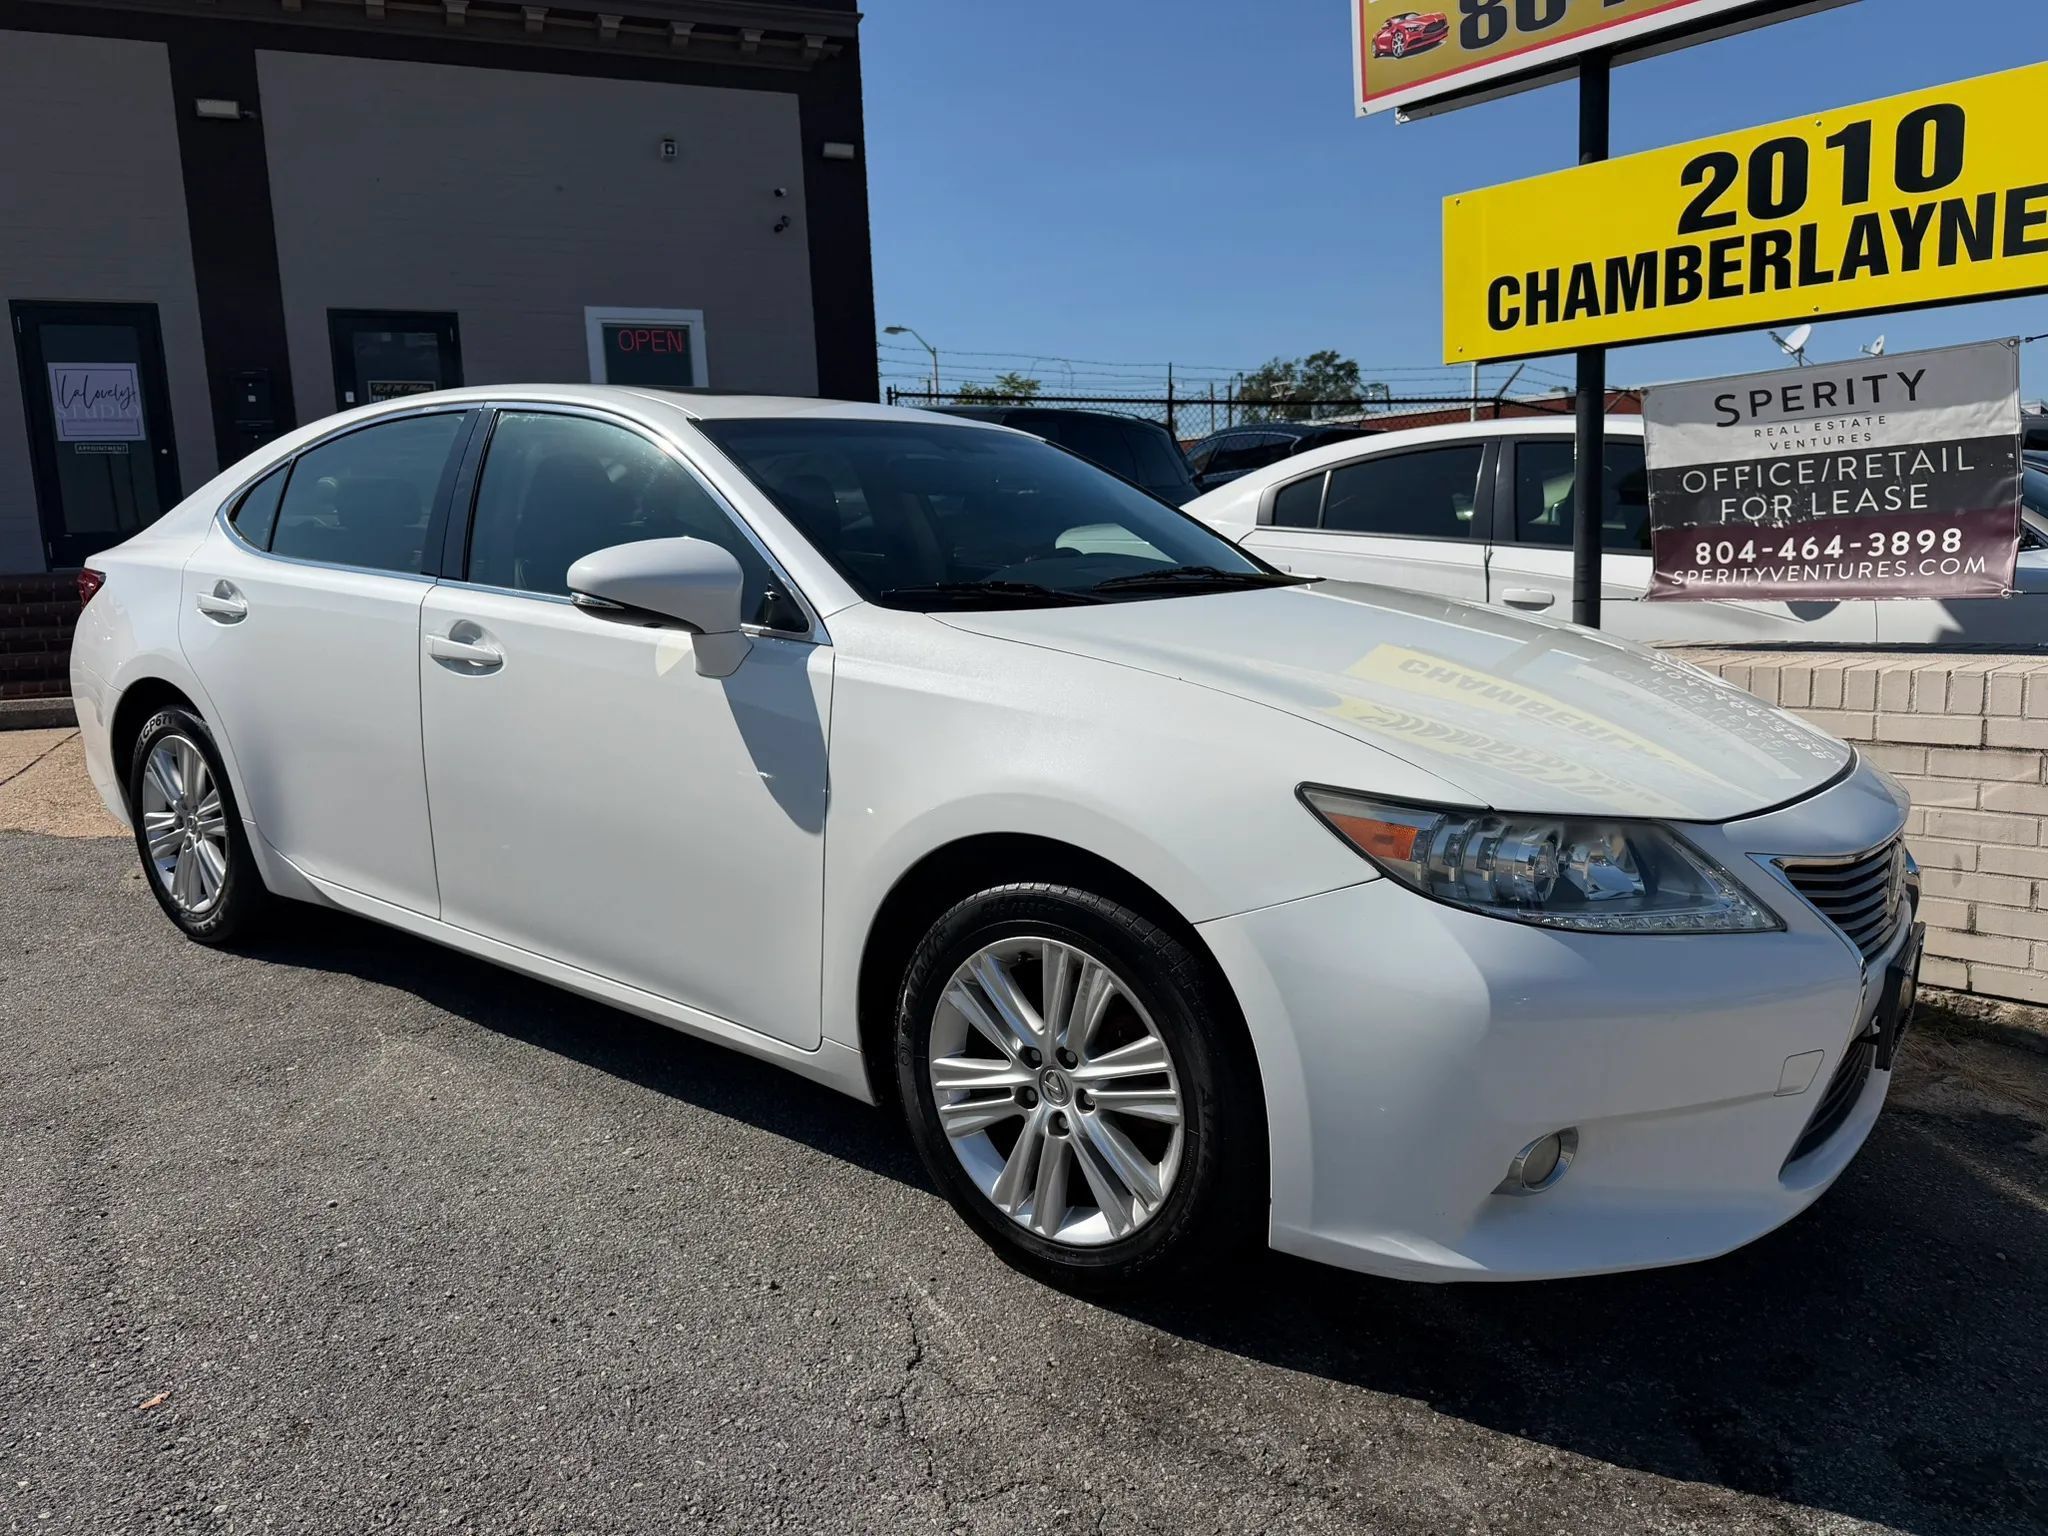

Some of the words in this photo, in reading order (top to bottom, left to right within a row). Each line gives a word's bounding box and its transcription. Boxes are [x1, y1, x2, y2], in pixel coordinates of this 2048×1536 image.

[1677, 102, 1966, 235] 2010
[1487, 181, 2048, 332] CHAMBERLAYNE
[618, 329, 684, 353] OPEN
[1714, 368, 1927, 428] SPERITY
[1754, 424, 1801, 438] REAL
[1814, 415, 1887, 432] ESTATE
[1769, 432, 1873, 451] VENTURES
[1682, 446, 1976, 494] OFFICE/RETAIL
[1720, 494, 1793, 522] FOR
[1811, 484, 1929, 517] LEASE
[1695, 528, 1963, 565] 804-464-3898
[1671, 556, 1986, 586] SPERITYVENTURES.COM
